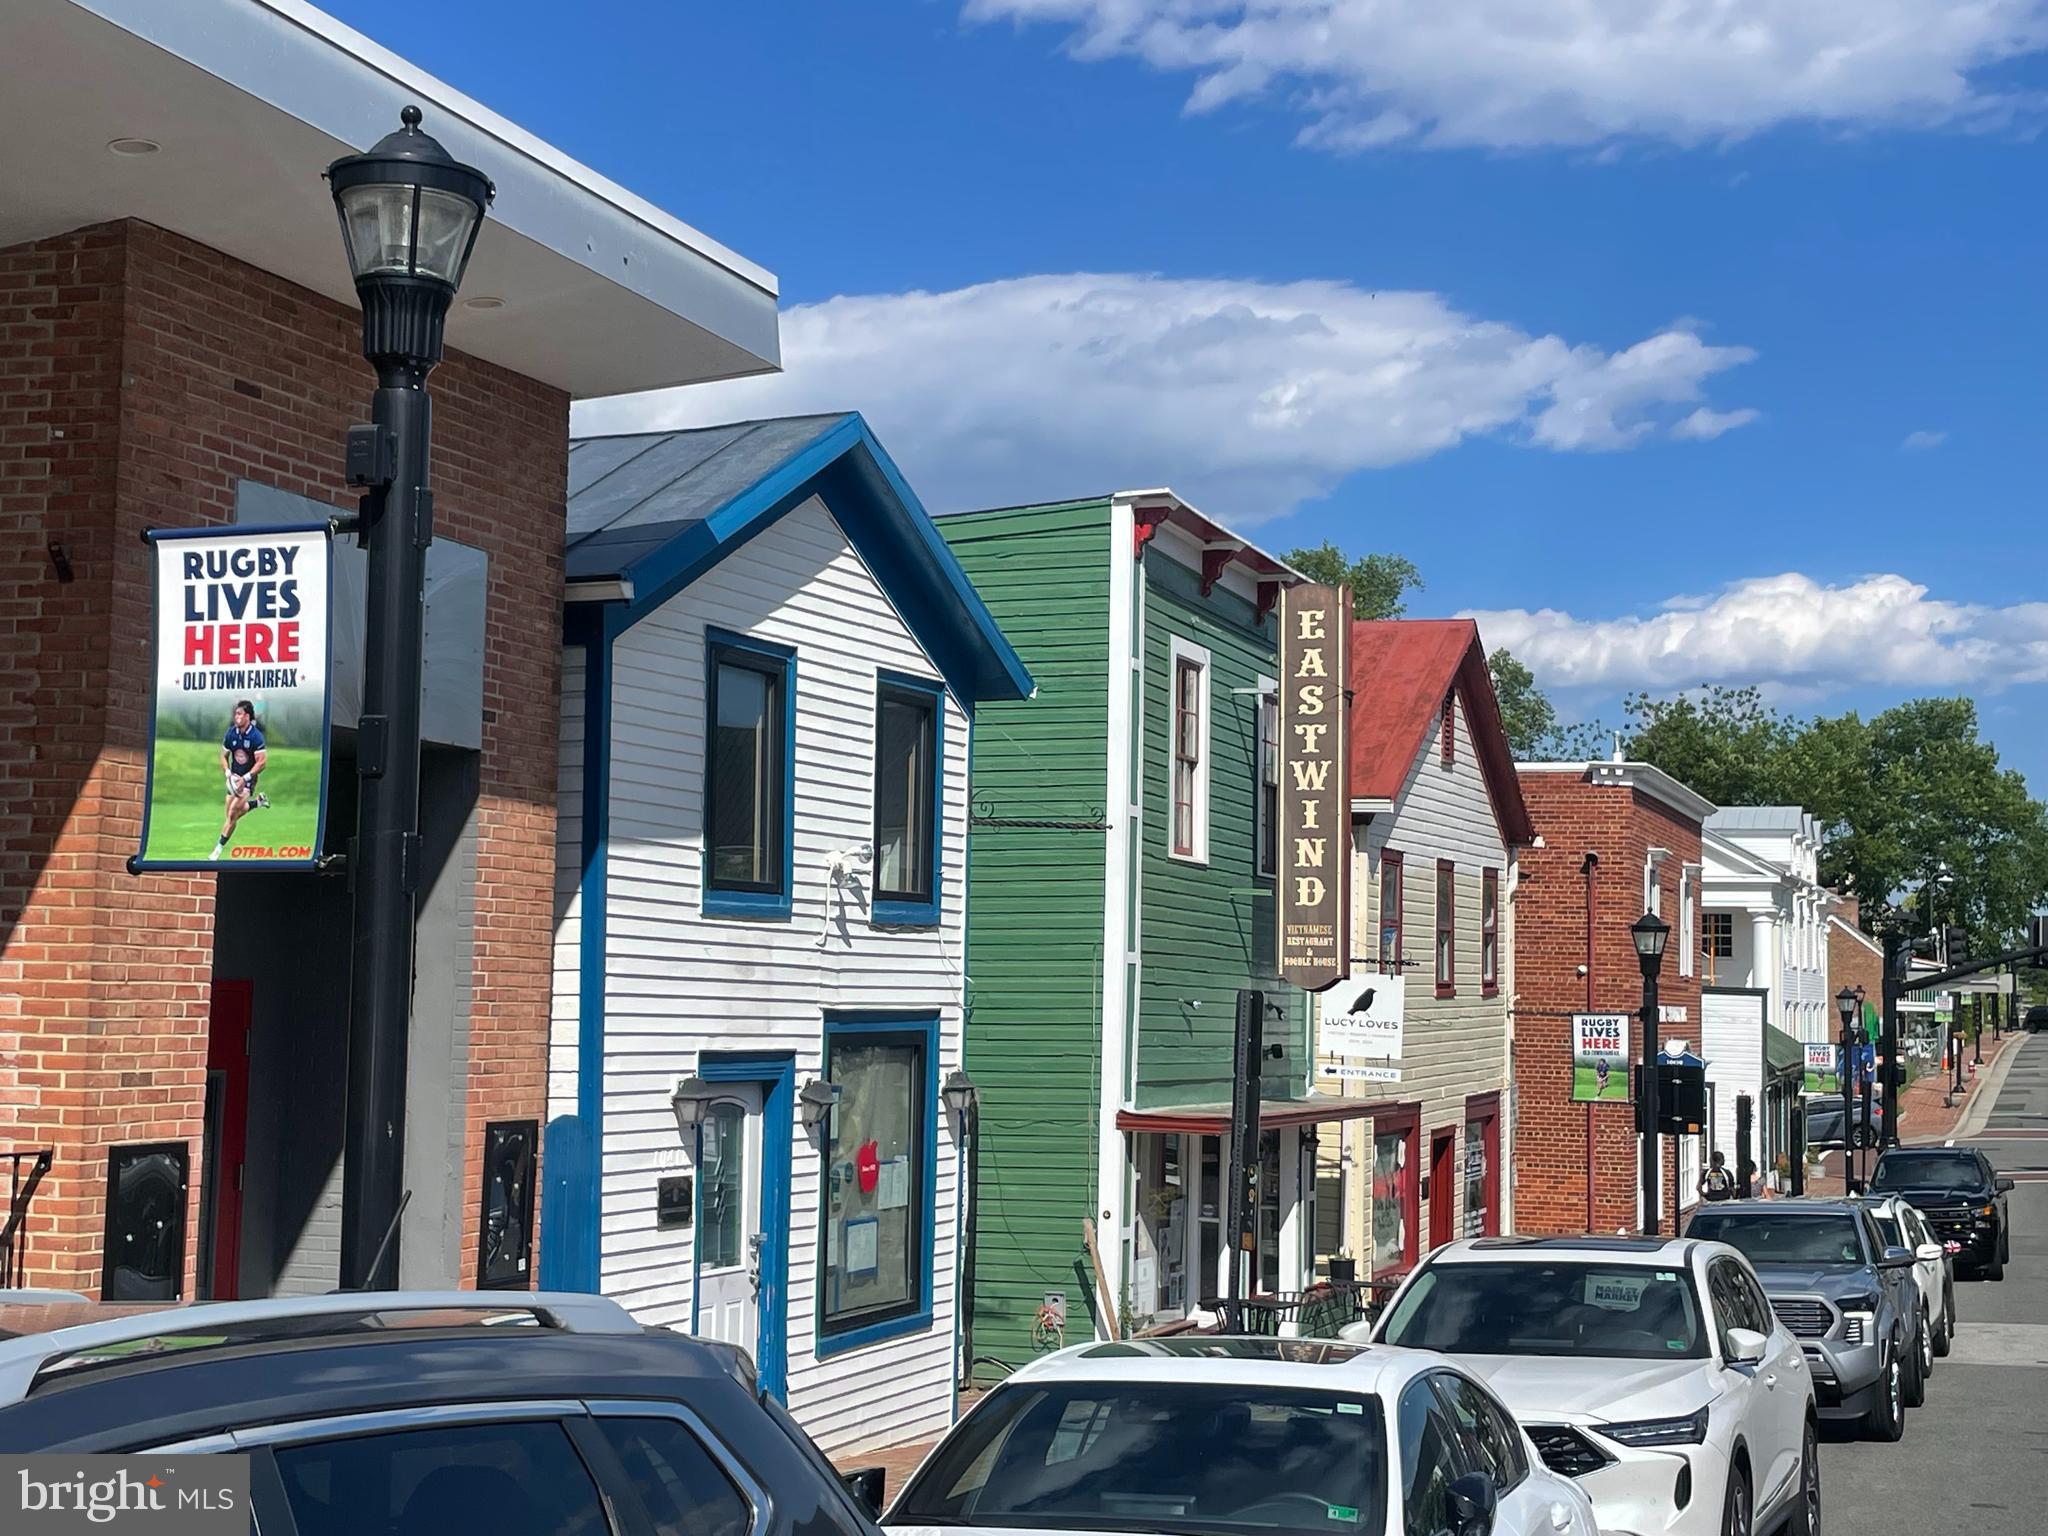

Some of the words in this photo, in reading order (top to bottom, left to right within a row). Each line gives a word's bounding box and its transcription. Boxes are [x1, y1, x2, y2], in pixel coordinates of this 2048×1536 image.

[183, 545, 301, 580] RUGBY
[184, 579, 301, 622] LIVES
[183, 621, 300, 666] HERE
[182, 670, 207, 691] OLD
[209, 669, 246, 690] TOWN
[247, 668, 298, 689] FAIRFAX
[1288, 609, 1333, 907] EASTWIND
[231, 845, 312, 859] OTFBA.COM
[1286, 924, 1333, 935] VIETNAMESE
[1286, 936, 1334, 947] RESTAURANT
[1306, 947, 1314, 957] &
[1324, 1017, 1356, 1028] LUCY
[1358, 1019, 1399, 1030] LOVES
[1581, 1018, 1620, 1027] RUGBY
[1581, 1027, 1621, 1038] LIVES
[1582, 1038, 1621, 1049] HERE
[1340, 1068, 1397, 1079] ENTRANCE
